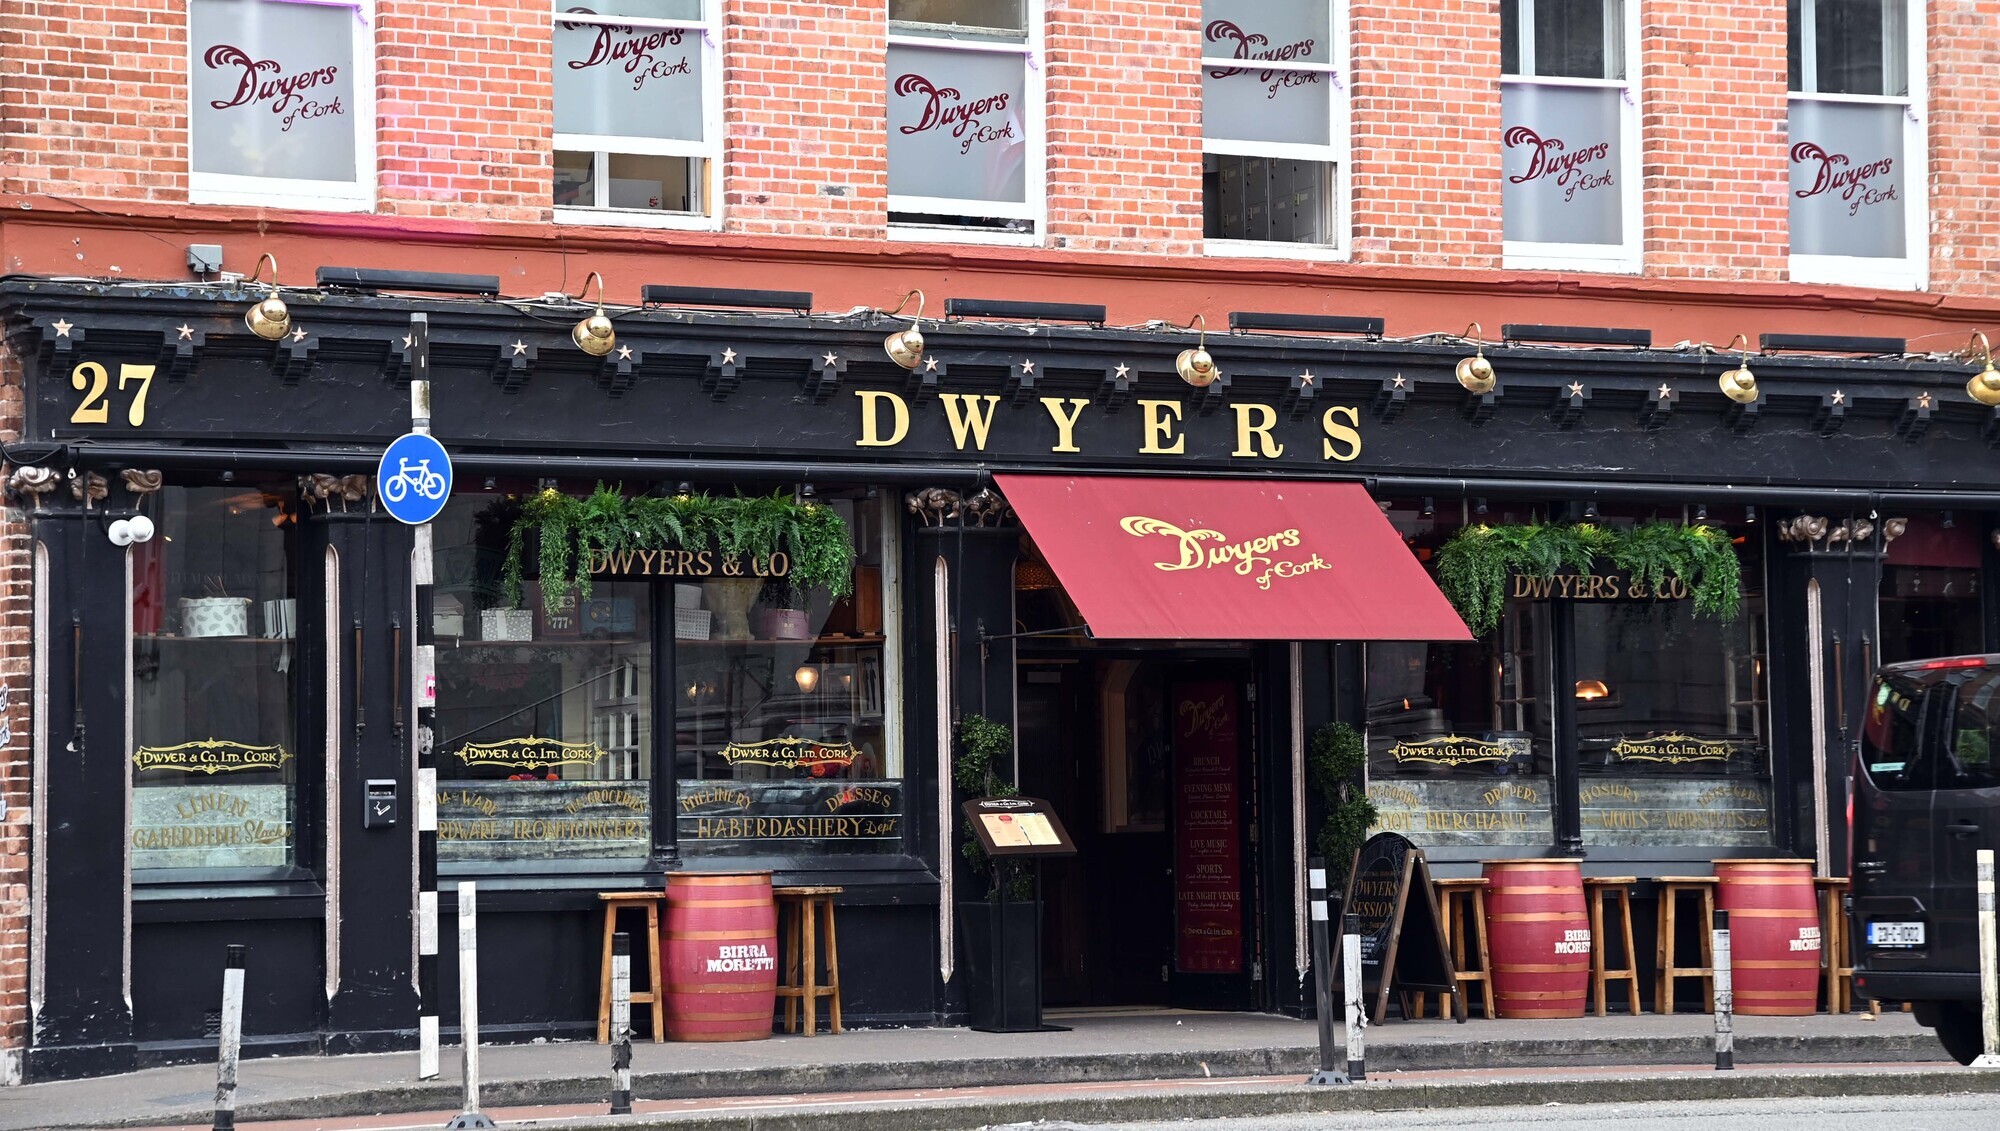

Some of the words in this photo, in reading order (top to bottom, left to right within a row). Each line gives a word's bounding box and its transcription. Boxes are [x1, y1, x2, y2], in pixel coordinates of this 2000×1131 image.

[562, 7, 685, 73] Dwyers
[203, 44, 338, 114] Dwyers
[633, 68, 650, 90] of
[651, 57, 691, 78] Cork
[1267, 77, 1283, 100] of
[1284, 70, 1320, 88] Cork
[281, 108, 297, 132] of
[301, 96, 345, 119] Cork
[894, 74, 1010, 138] Dwyers
[960, 133, 975, 155] of
[977, 121, 1015, 143] Cork
[1504, 125, 1609, 186] Dwyers
[1790, 141, 1893, 201] Dwyers
[1564, 180, 1579, 202] of
[1580, 169, 1615, 191] Cork
[1849, 195, 1864, 216] of
[1864, 183, 1899, 205] Cork
[70, 361, 156, 427] 27
[854, 390, 1362, 462] DWYERS
[588, 548, 713, 576] DWYERS
[721, 552, 745, 576] &
[1119, 515, 1301, 576] Dwyers
[1255, 567, 1274, 591] of
[1274, 553, 1333, 578] Cork
[1513, 573, 1620, 599] DWYERS
[1627, 575, 1648, 598] &
[176, 792, 249, 819] LINEN
[680, 786, 755, 813] MILLINERY
[825, 787, 892, 813] DRESSES
[1482, 785, 1540, 807] DRAPERY
[437, 820, 500, 840] RDWARE
[513, 820, 645, 840] IRONMONGERY
[697, 817, 864, 839] HABERDASHERY
[1426, 812, 1528, 831] MERCHANT
[1196, 863, 1223, 873] SPORTS
[707, 957, 774, 973] MORETTI
[719, 944, 768, 959] BIRRA
